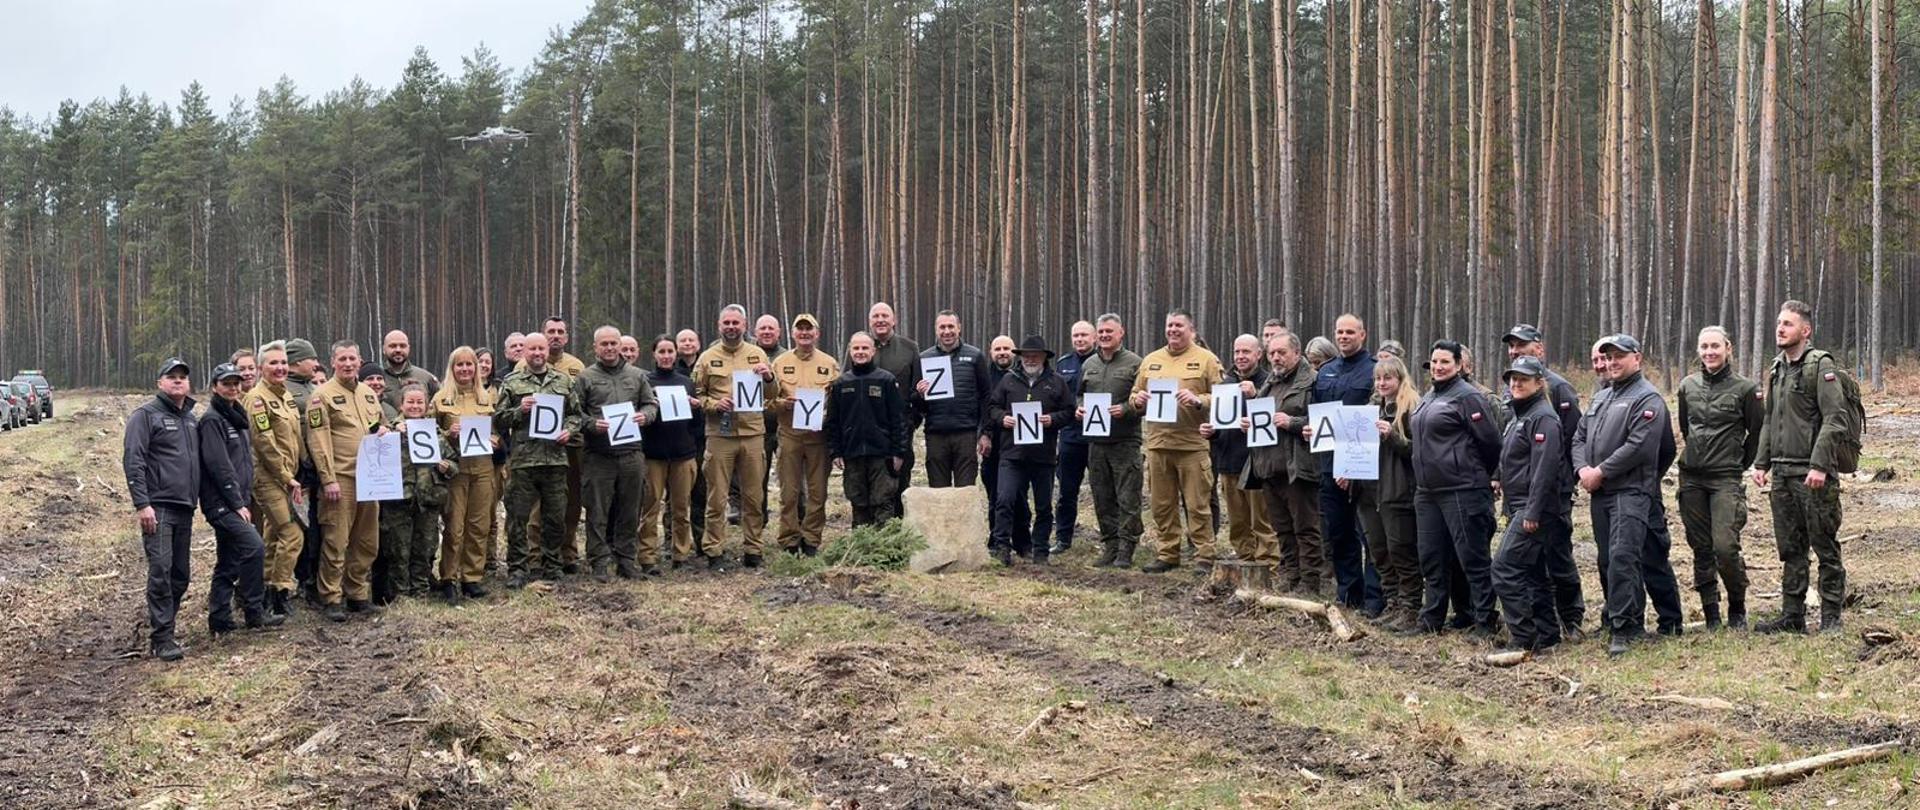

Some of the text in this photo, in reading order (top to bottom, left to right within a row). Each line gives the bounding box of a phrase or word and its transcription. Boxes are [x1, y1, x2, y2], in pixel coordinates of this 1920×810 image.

[737, 378, 765, 409] M
[925, 367, 948, 397] Z
[672, 393, 679, 418] I
[795, 398, 821, 427] Y
[1085, 404, 1107, 433] A
[1150, 390, 1172, 419] T
[1215, 395, 1238, 426] U
[534, 404, 559, 435] D
[609, 413, 635, 442] Z
[1016, 412, 1040, 441] N
[1251, 410, 1276, 443] R
[412, 430, 435, 460] S
[463, 427, 488, 453] A
